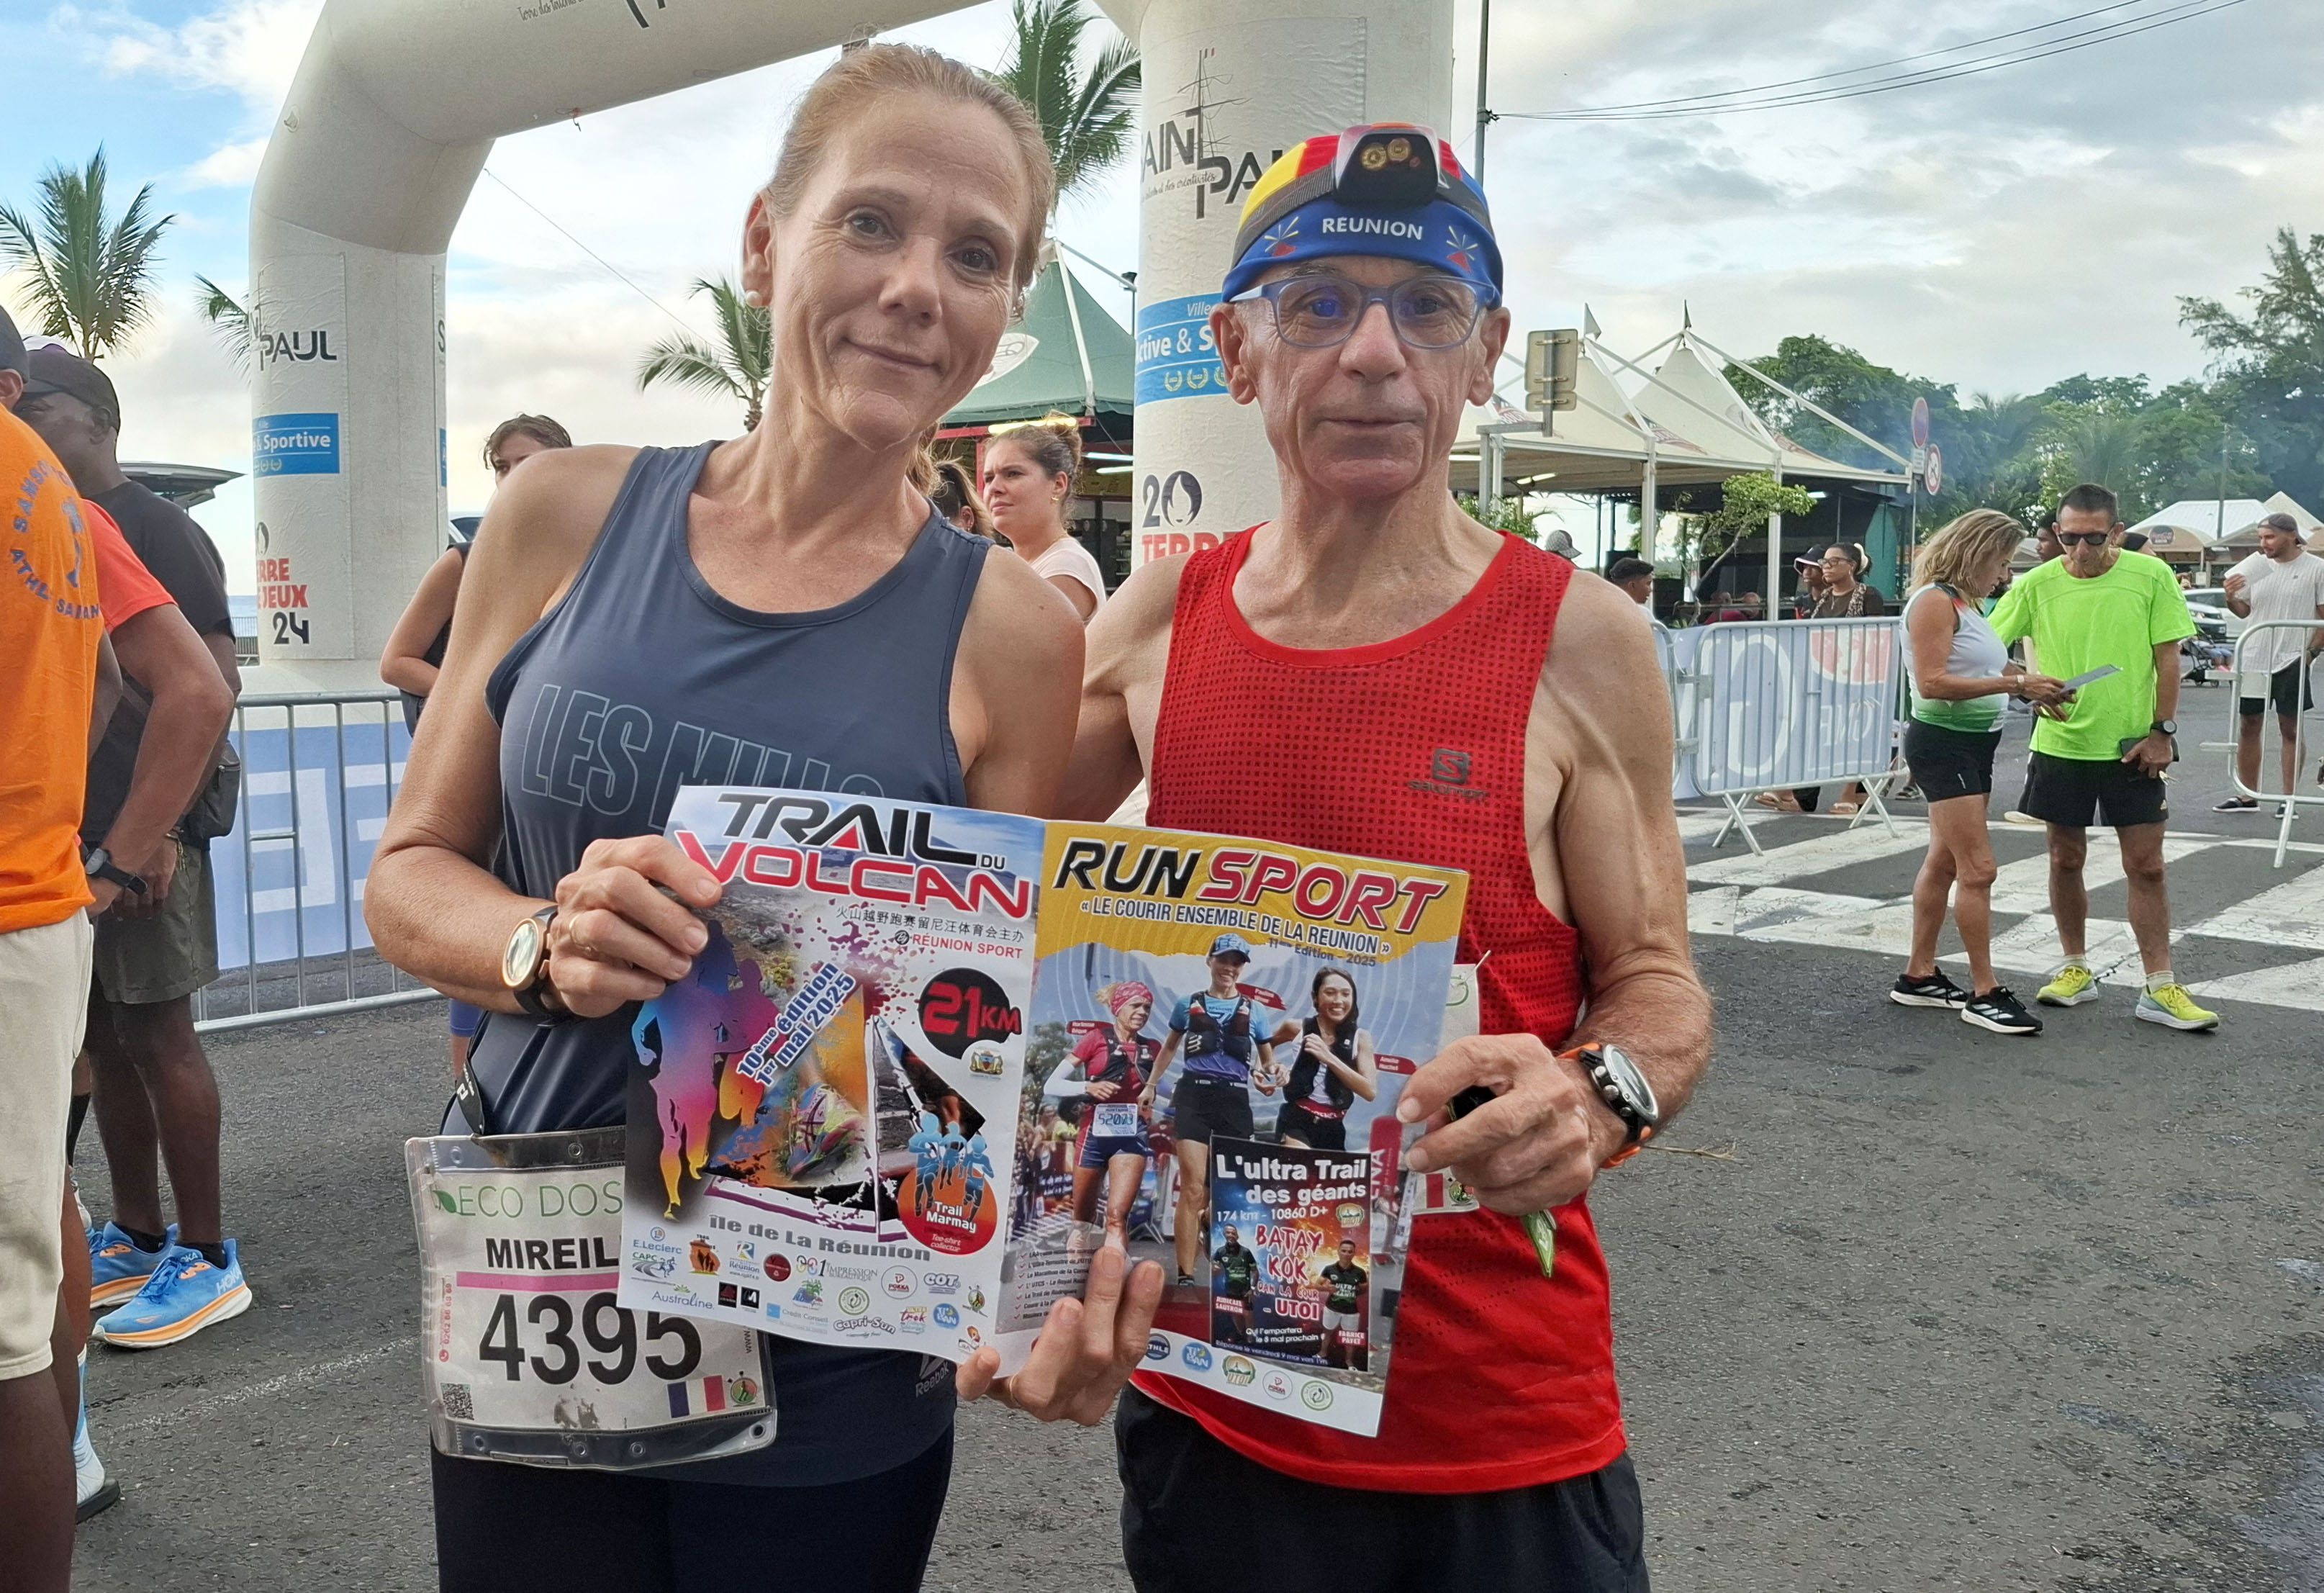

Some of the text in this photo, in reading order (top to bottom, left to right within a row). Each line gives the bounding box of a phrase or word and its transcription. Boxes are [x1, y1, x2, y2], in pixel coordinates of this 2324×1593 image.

[1196, 150, 1283, 219] PA
[1187, 302, 1211, 317] Ville
[260, 330, 338, 371] PAUL
[1138, 335, 1172, 362] ctive
[1177, 328, 1192, 353] &
[263, 431, 331, 453] Sportive
[1141, 531, 1247, 564] TER
[263, 585, 308, 609] JEUX
[273, 612, 309, 645] 24
[521, 684, 653, 816] LES
[718, 793, 1006, 870] TRAIL DU
[675, 831, 1031, 920] VOLCAN
[1053, 838, 1448, 934] RUN SPORT
[836, 906, 1024, 944] 火山越野跑赛留尼汪体育会主办
[1093, 896, 1111, 915] LE
[1115, 898, 1171, 921] COURIR
[1177, 906, 1257, 930] ENSEMBLE
[1260, 916, 1280, 935] DE
[1285, 919, 1303, 941] LA
[1307, 926, 1378, 953] REUNION
[912, 932, 1023, 959] RÉUNION SPORT
[1295, 944, 1334, 960] Edition
[1347, 953, 1376, 967] 2025
[777, 963, 838, 1033] édition
[756, 974, 856, 1085] 1er mai 2025
[1216, 1154, 1307, 1180] L'ultra
[1315, 1158, 1366, 1180] Trail
[459, 1184, 523, 1218] ECO
[934, 1201, 962, 1217] Trail
[1246, 1181, 1366, 1206] des géants
[926, 1211, 977, 1233] Marmay
[1217, 1210, 1237, 1222] 174
[1271, 1207, 1306, 1219] 10860
[486, 1236, 622, 1269] MIREIL
[633, 1240, 682, 1255] E.Leclerc
[633, 1251, 657, 1261] CAPC
[749, 1223, 779, 1240] de
[786, 1230, 812, 1248] La
[819, 1238, 930, 1261] Réunion
[1256, 1224, 1324, 1257] BATAY
[1267, 1254, 1309, 1285] KOK
[833, 1316, 897, 1335] Capri-Sun
[1275, 1297, 1319, 1321] UTOI
[479, 1293, 703, 1386] 4395
[915, 1360, 949, 1398] Reebok
